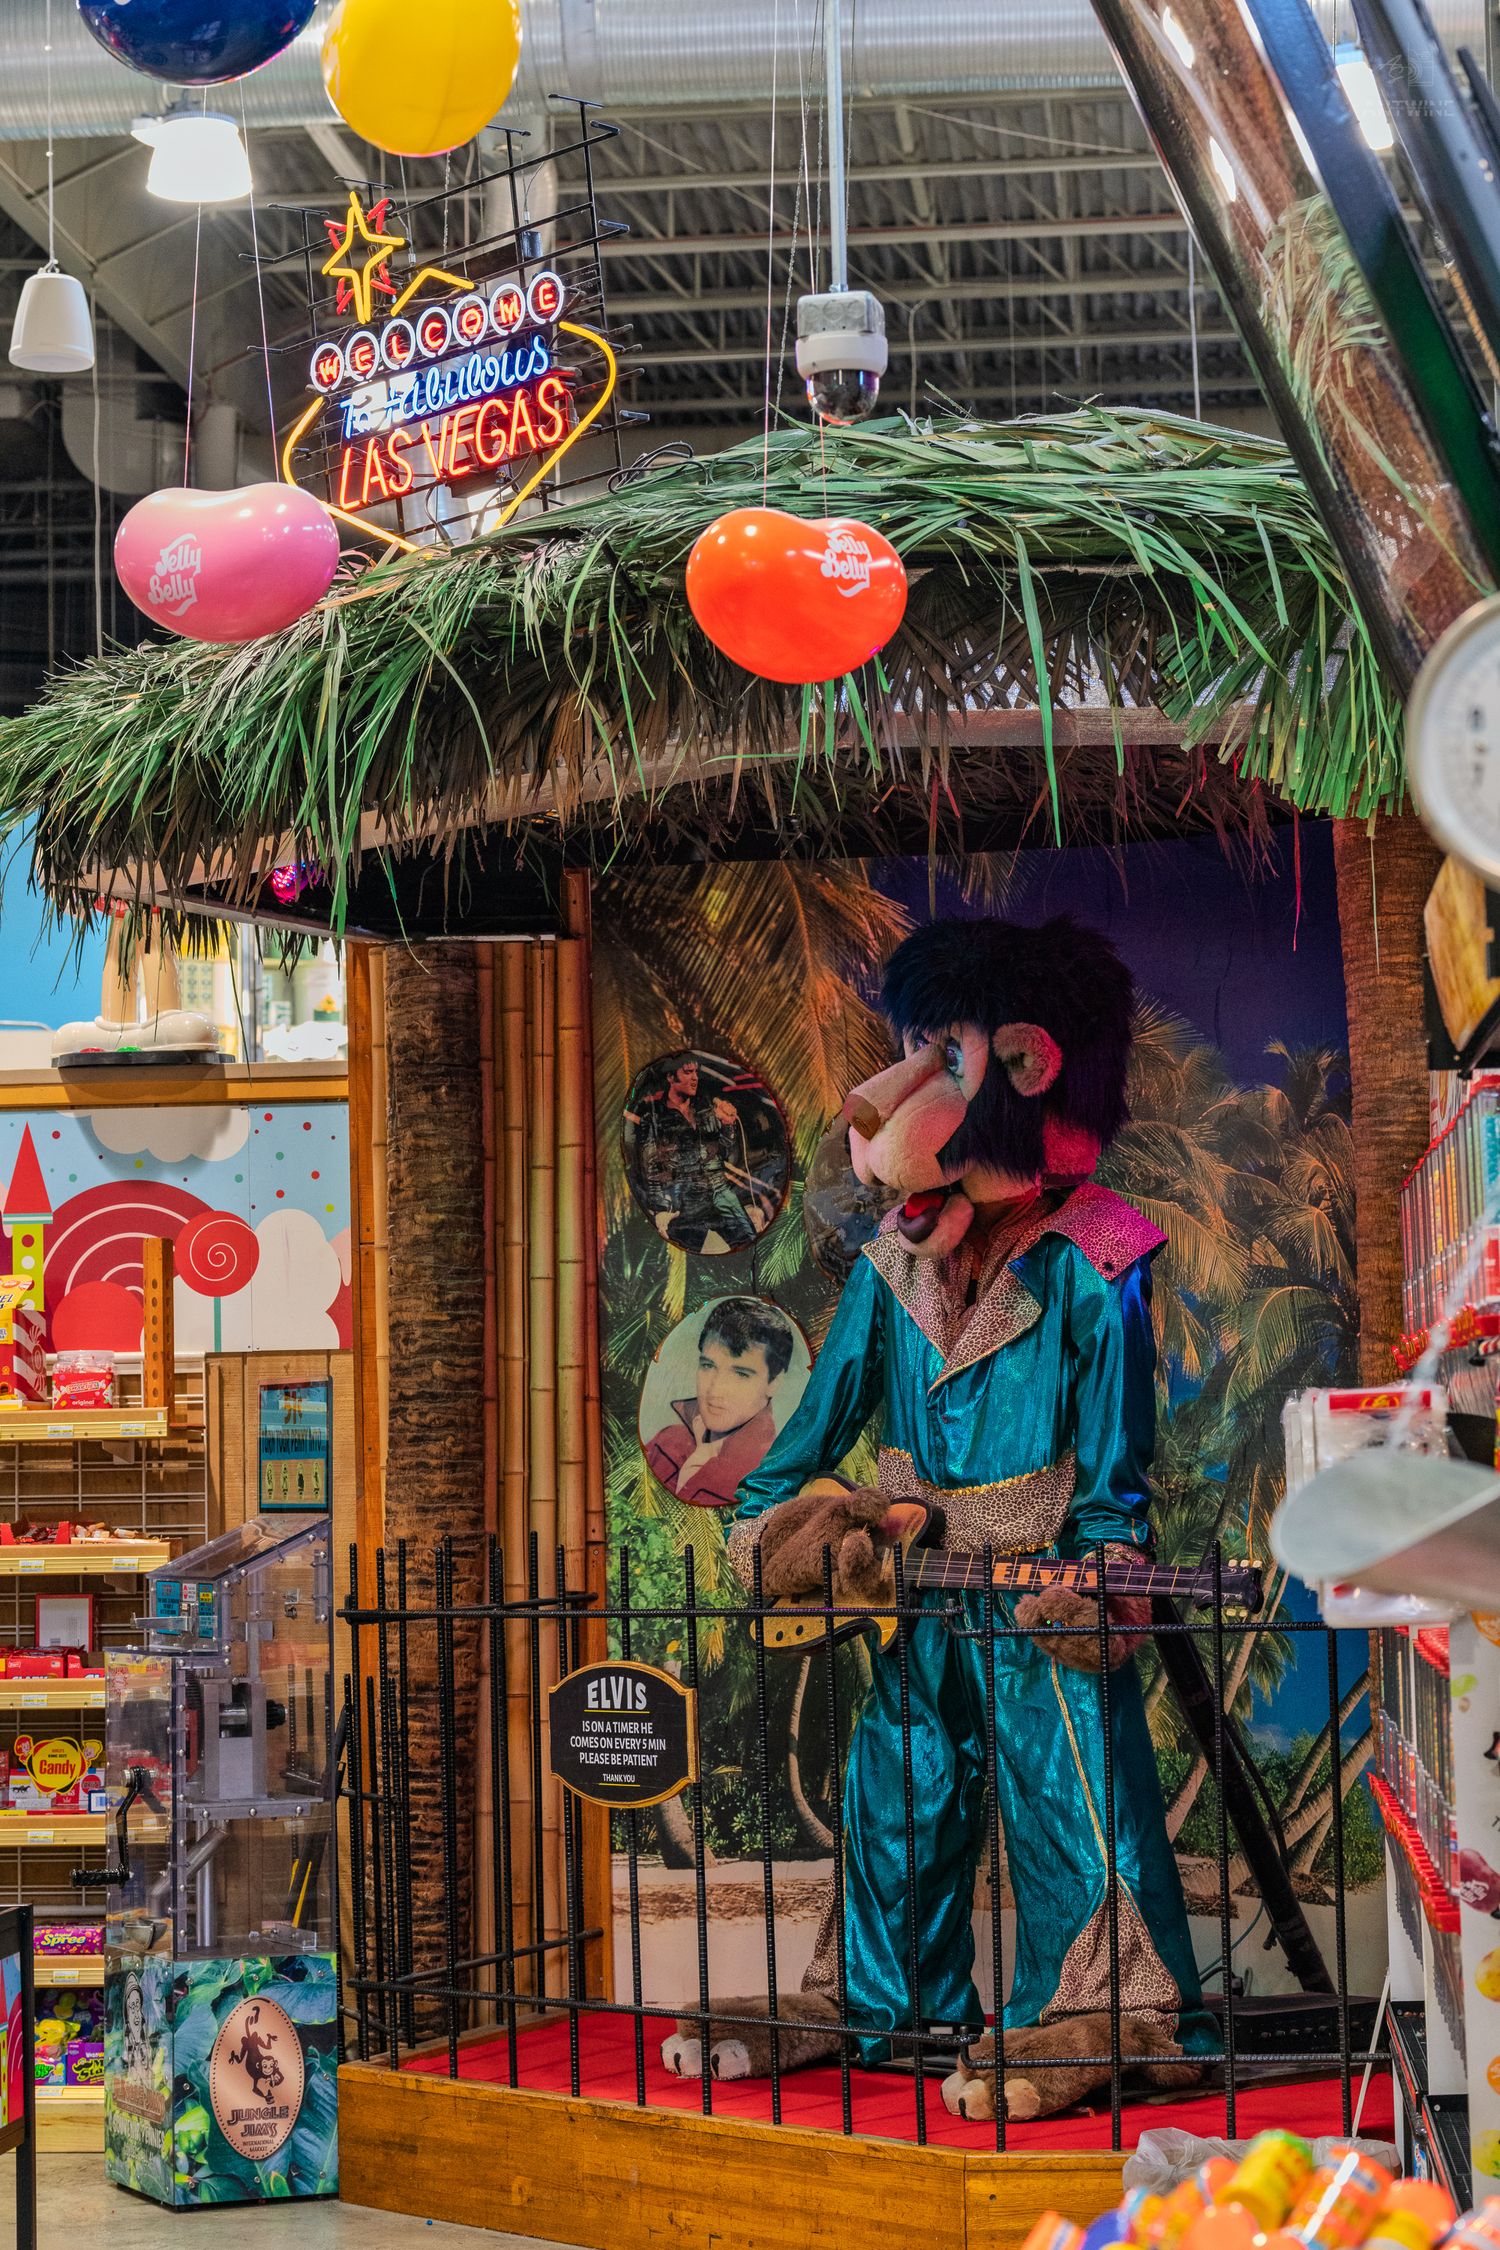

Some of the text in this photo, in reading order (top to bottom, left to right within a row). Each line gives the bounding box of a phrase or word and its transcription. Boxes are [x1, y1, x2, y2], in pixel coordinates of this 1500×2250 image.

[313, 275, 561, 389] WELCOME
[340, 377, 564, 511] LAS VEGAS
[155, 534, 202, 577] Jelly
[826, 530, 873, 563] Jelly
[820, 549, 873, 592] Belly
[148, 573, 199, 613] Belly
[992, 1562, 1098, 1588] Elvis
[587, 1676, 647, 1711] ELVIS
[582, 1720, 653, 1734] IS ON A TIMER HE
[570, 1736, 666, 1751] COMES ON EVERY 5 MIN
[39, 1760, 76, 1779] Candy
[579, 1752, 658, 1767] PLEASE BE PATIENT
[602, 1773, 636, 1783] THANK YOU
[41, 1934, 87, 1947] Spree
[227, 2105, 289, 2126] JUNGLE
[240, 2122, 277, 2138] JIM'S
